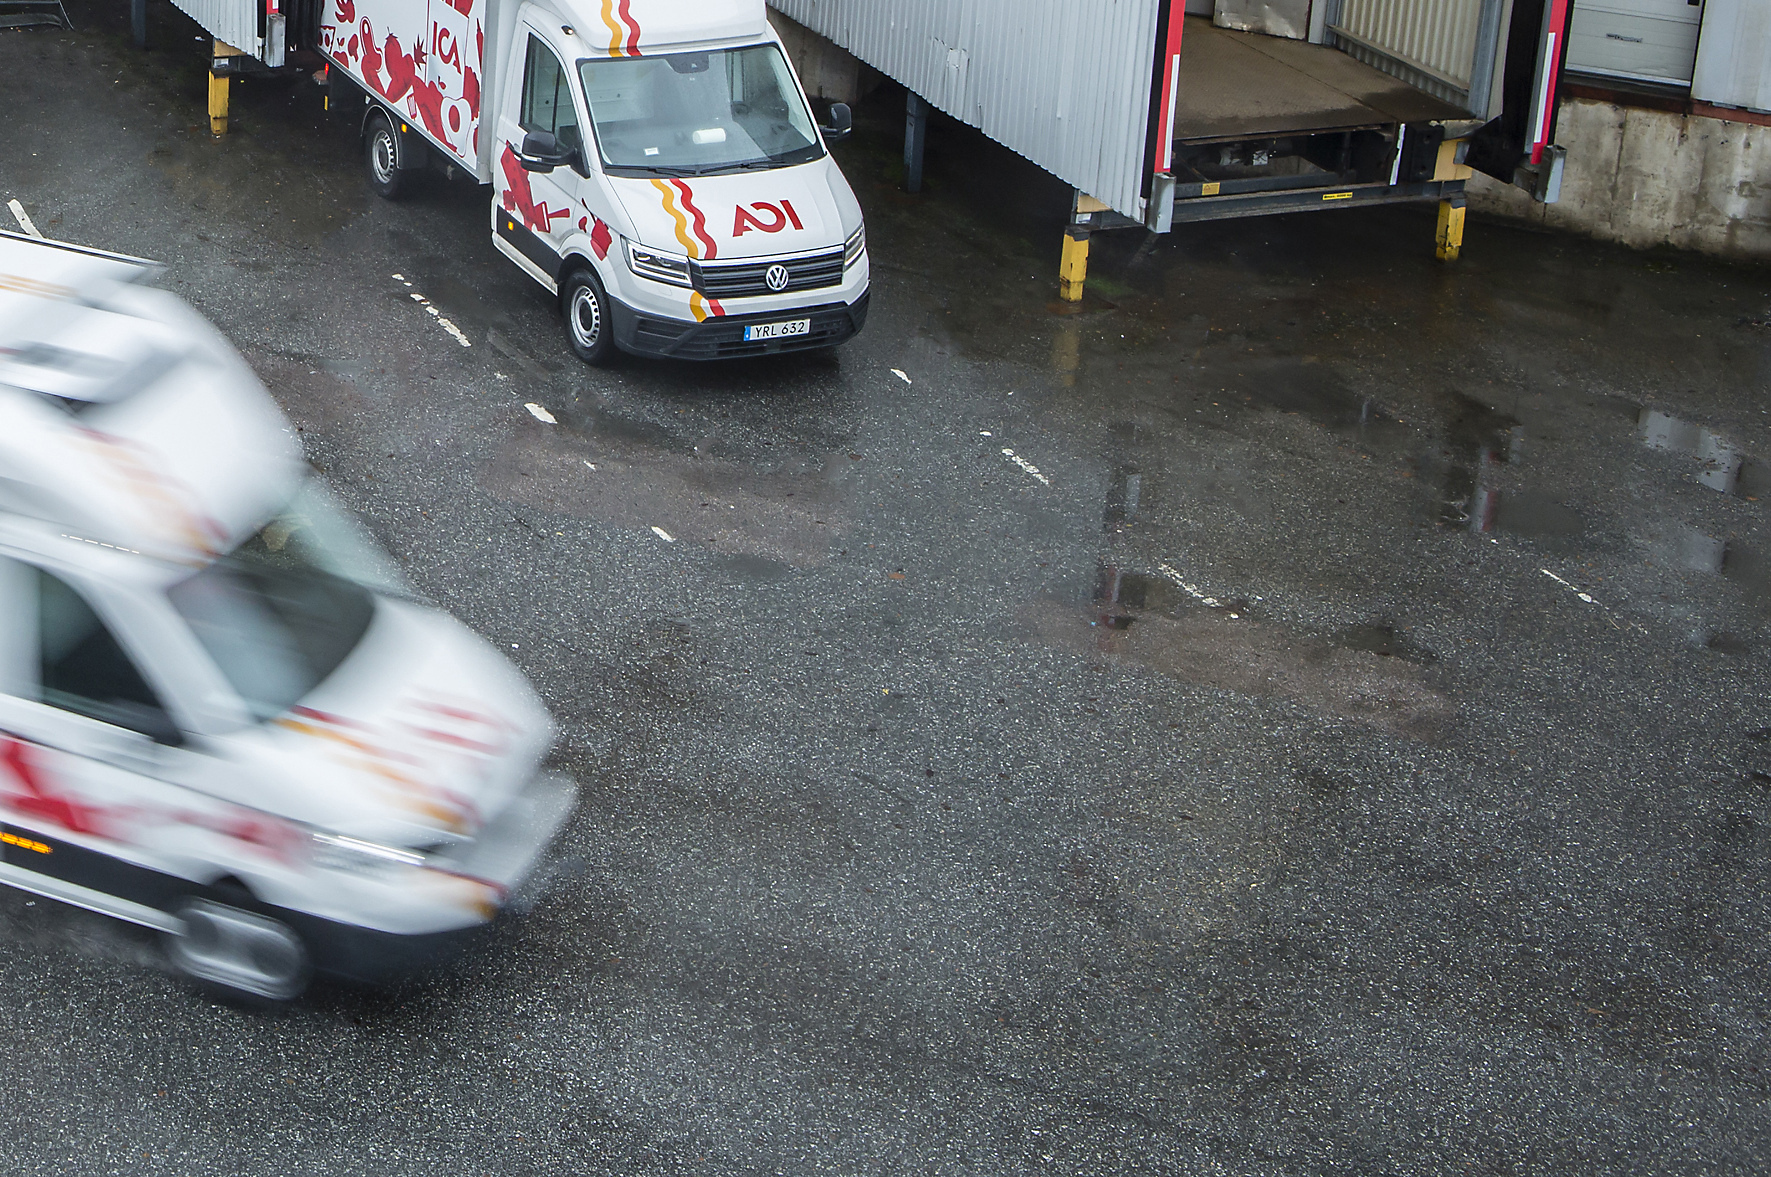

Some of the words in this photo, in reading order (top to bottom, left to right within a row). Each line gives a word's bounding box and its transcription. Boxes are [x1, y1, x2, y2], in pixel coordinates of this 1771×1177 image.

[432, 20, 462, 75] ICA
[756, 326, 777, 338] YRL
[782, 321, 805, 334] 632
